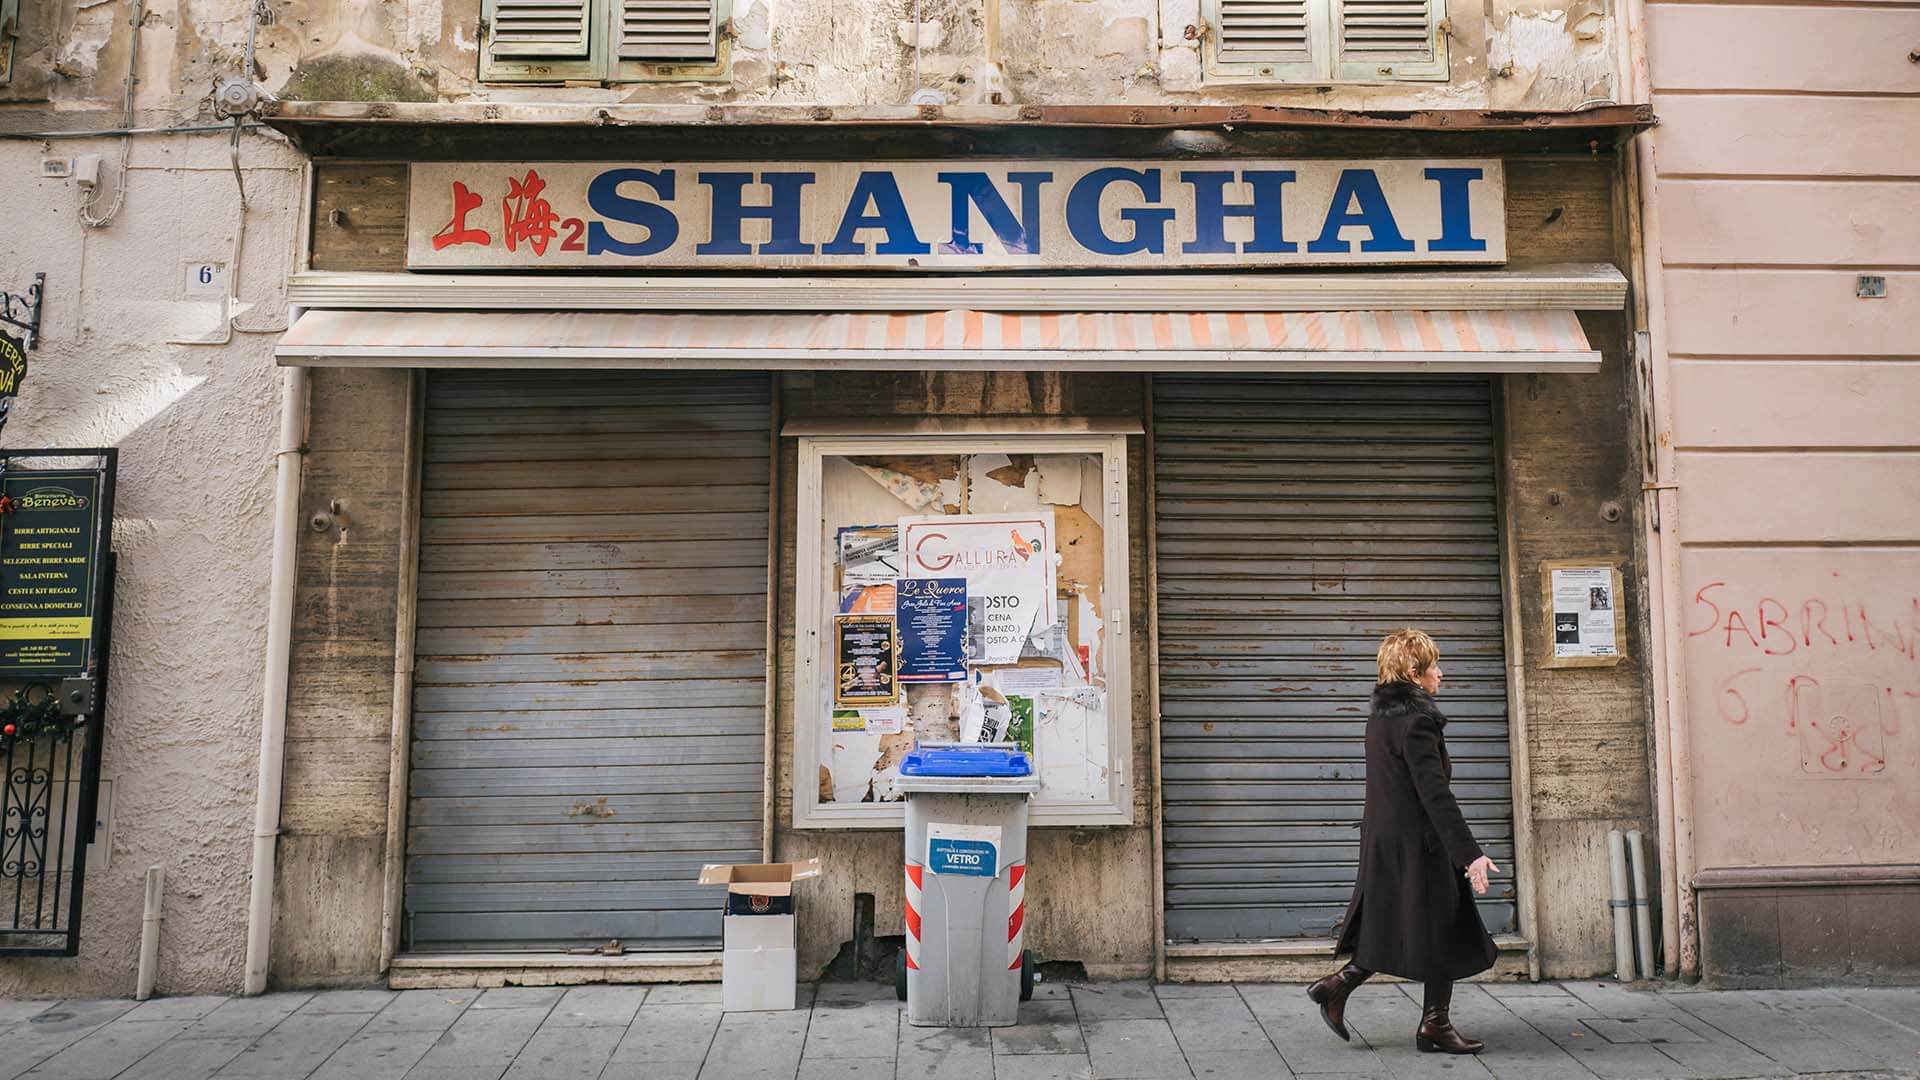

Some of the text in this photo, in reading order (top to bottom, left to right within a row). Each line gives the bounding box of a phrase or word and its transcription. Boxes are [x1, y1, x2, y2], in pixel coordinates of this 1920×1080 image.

[433, 169, 558, 256] 上海
[560, 167, 1487, 257] 2 SHANGHAI
[200, 265, 212, 284] 6
[916, 533, 1017, 571] GALLURA
[48, 586, 78, 594] REGALO
[898, 580, 966, 599] Le Querce
[988, 613, 1012, 622] CENA
[946, 853, 980, 865] VETRO
